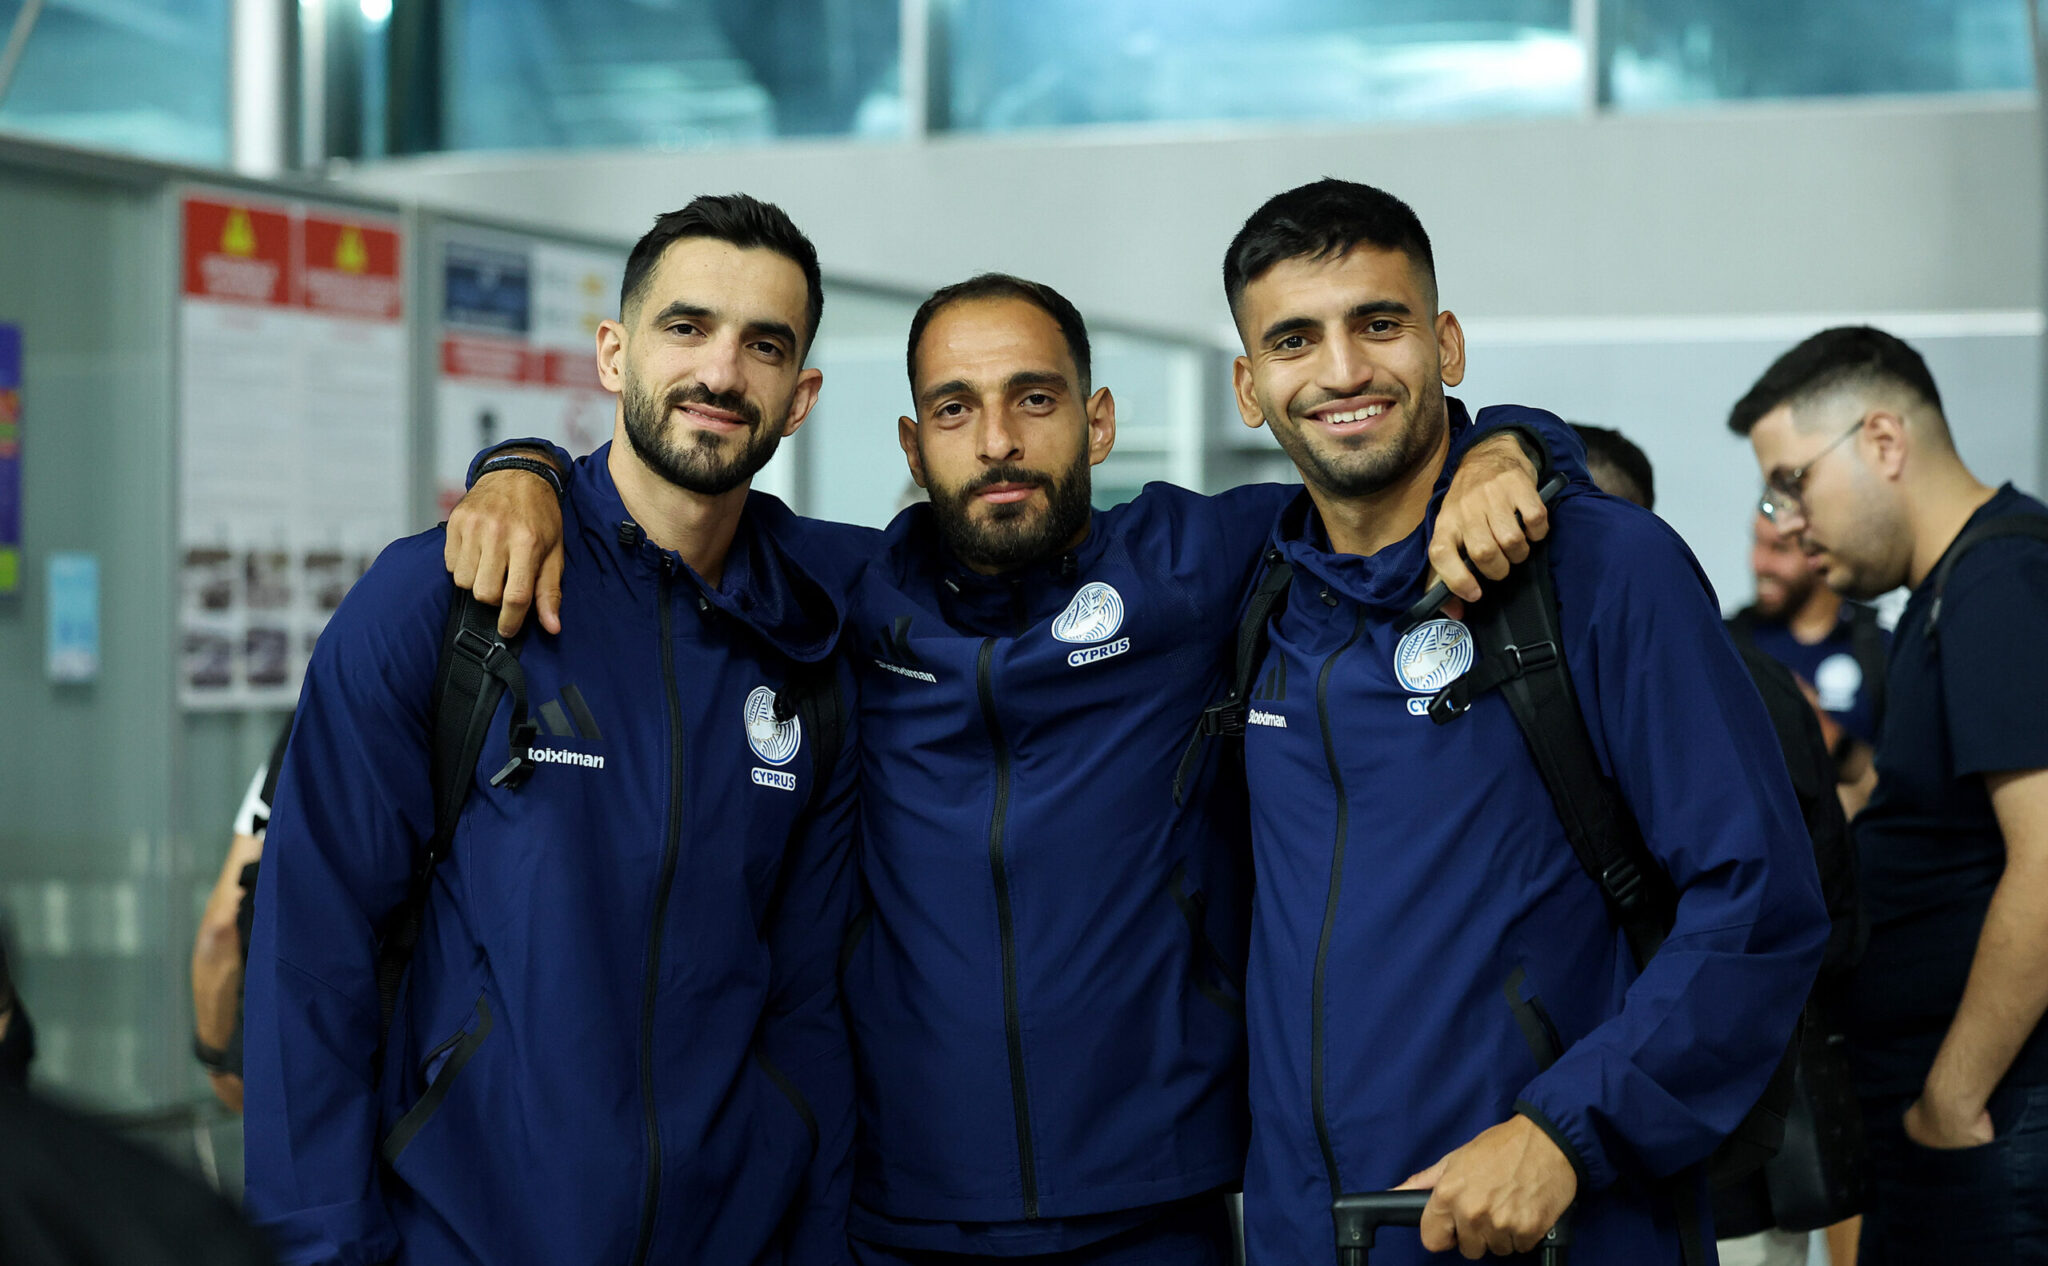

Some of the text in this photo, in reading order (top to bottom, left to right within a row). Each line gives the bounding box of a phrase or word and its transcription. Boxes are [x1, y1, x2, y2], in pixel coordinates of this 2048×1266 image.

[1069, 638, 1129, 665] CYPRUS
[528, 747, 605, 769] toiximan
[752, 769, 795, 789] CYPRUS
